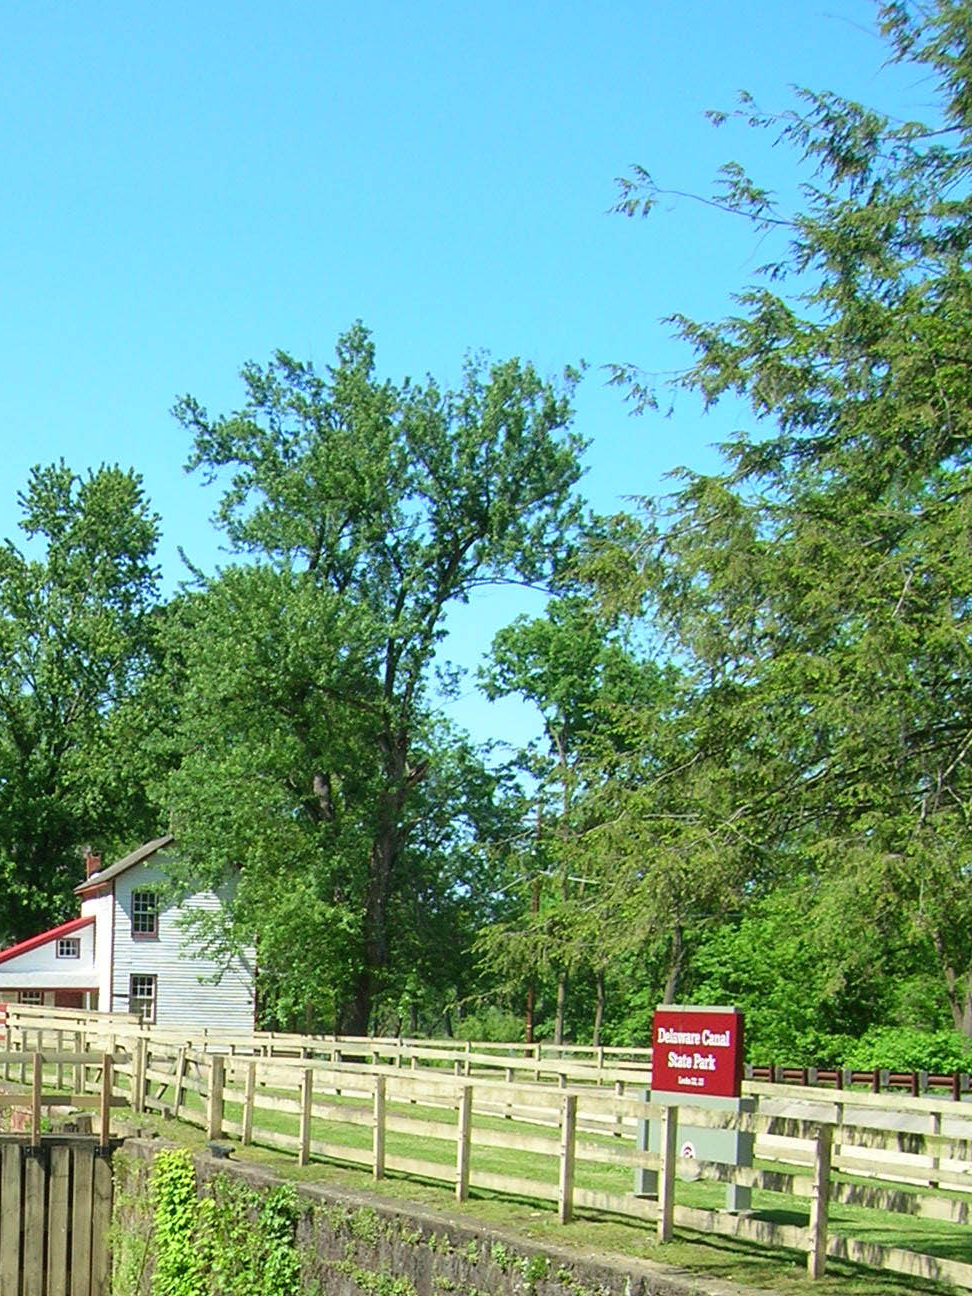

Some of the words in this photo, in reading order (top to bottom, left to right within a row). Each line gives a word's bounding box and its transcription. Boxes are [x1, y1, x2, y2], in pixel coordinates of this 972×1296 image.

[657, 1027, 701, 1045] Delaware
[702, 1029, 730, 1047] Canal
[668, 1051, 692, 1069] State
[693, 1053, 716, 1071] Park
